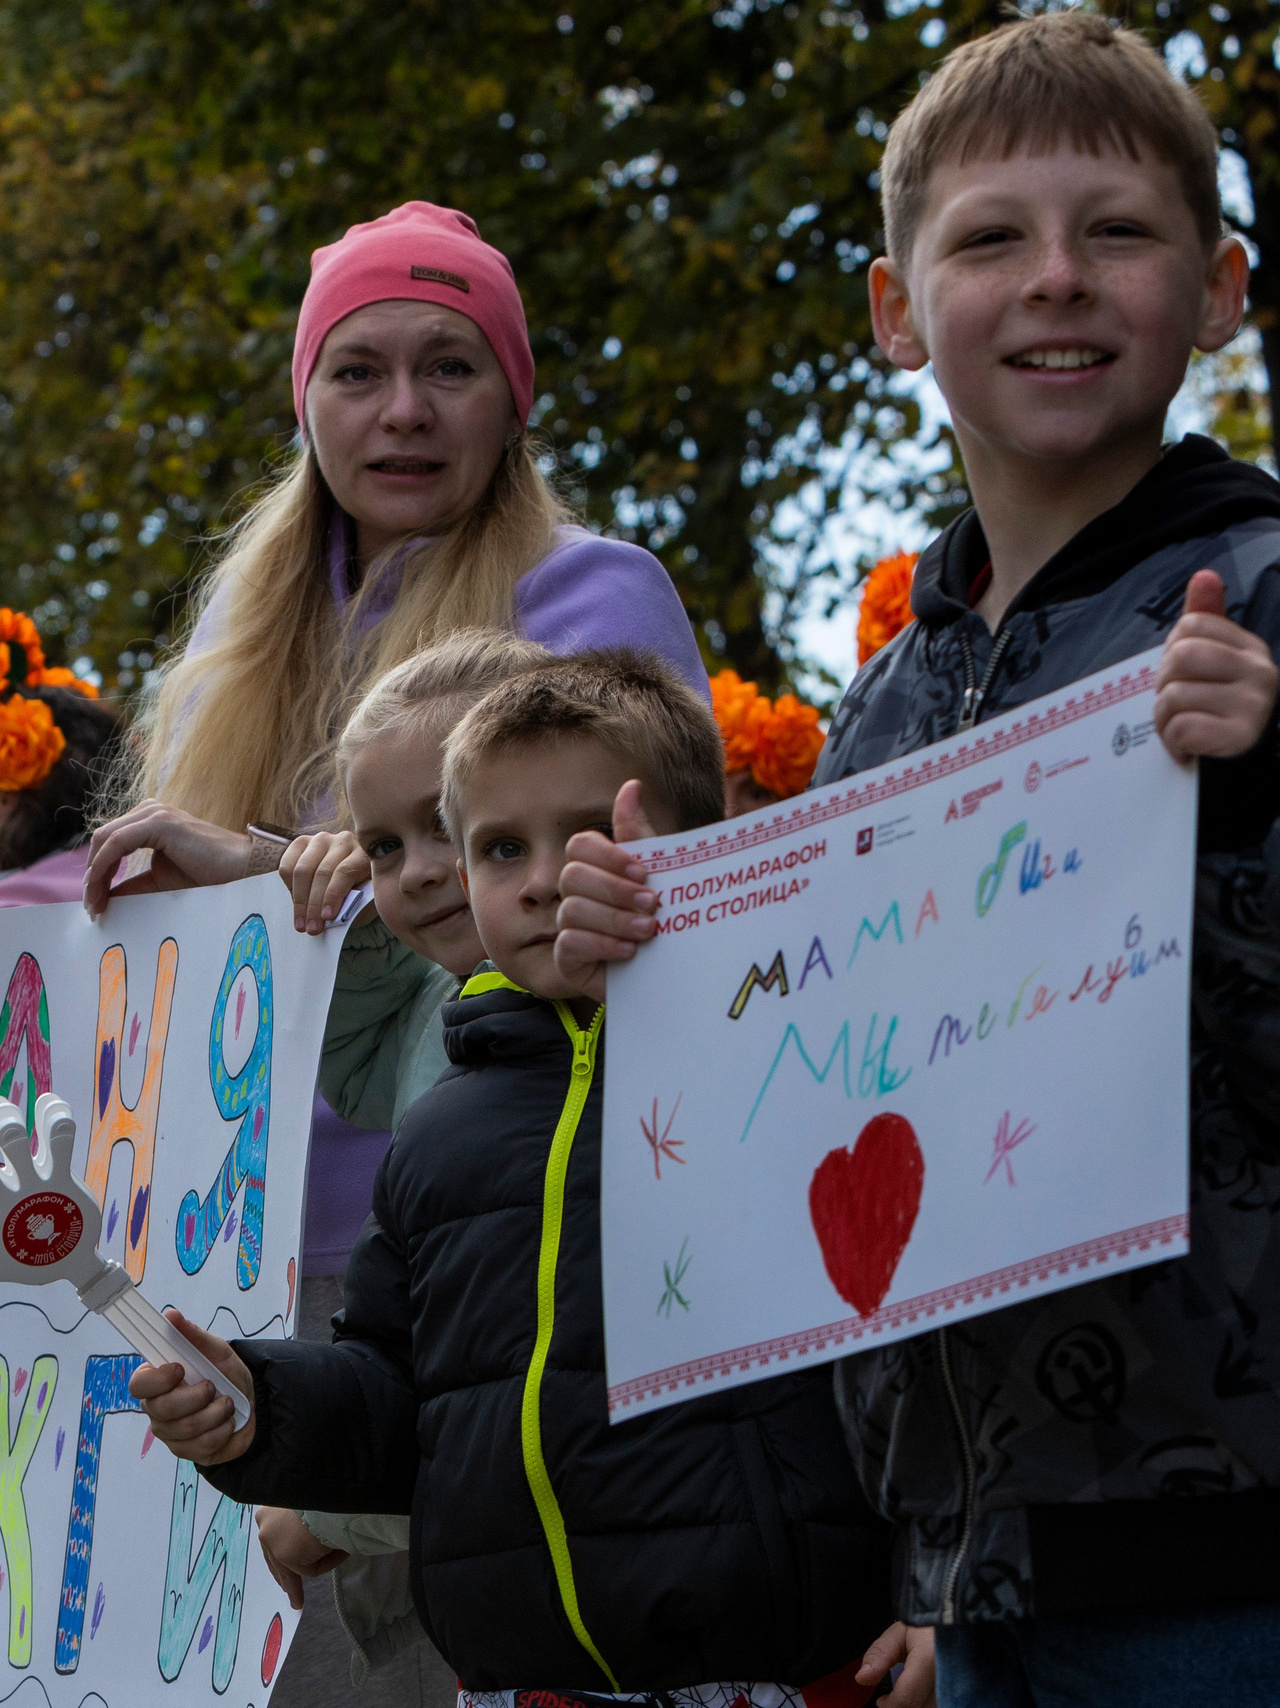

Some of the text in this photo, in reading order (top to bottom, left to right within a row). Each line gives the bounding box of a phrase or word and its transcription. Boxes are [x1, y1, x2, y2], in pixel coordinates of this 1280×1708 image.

[670, 839, 827, 905] ПОЛУМАРАФОН
[706, 878, 810, 922] СТОЛИЦА»
[728, 889, 939, 1020] МАМА
[7, 1196, 65, 1238] ПОЛУМАРАФОН
